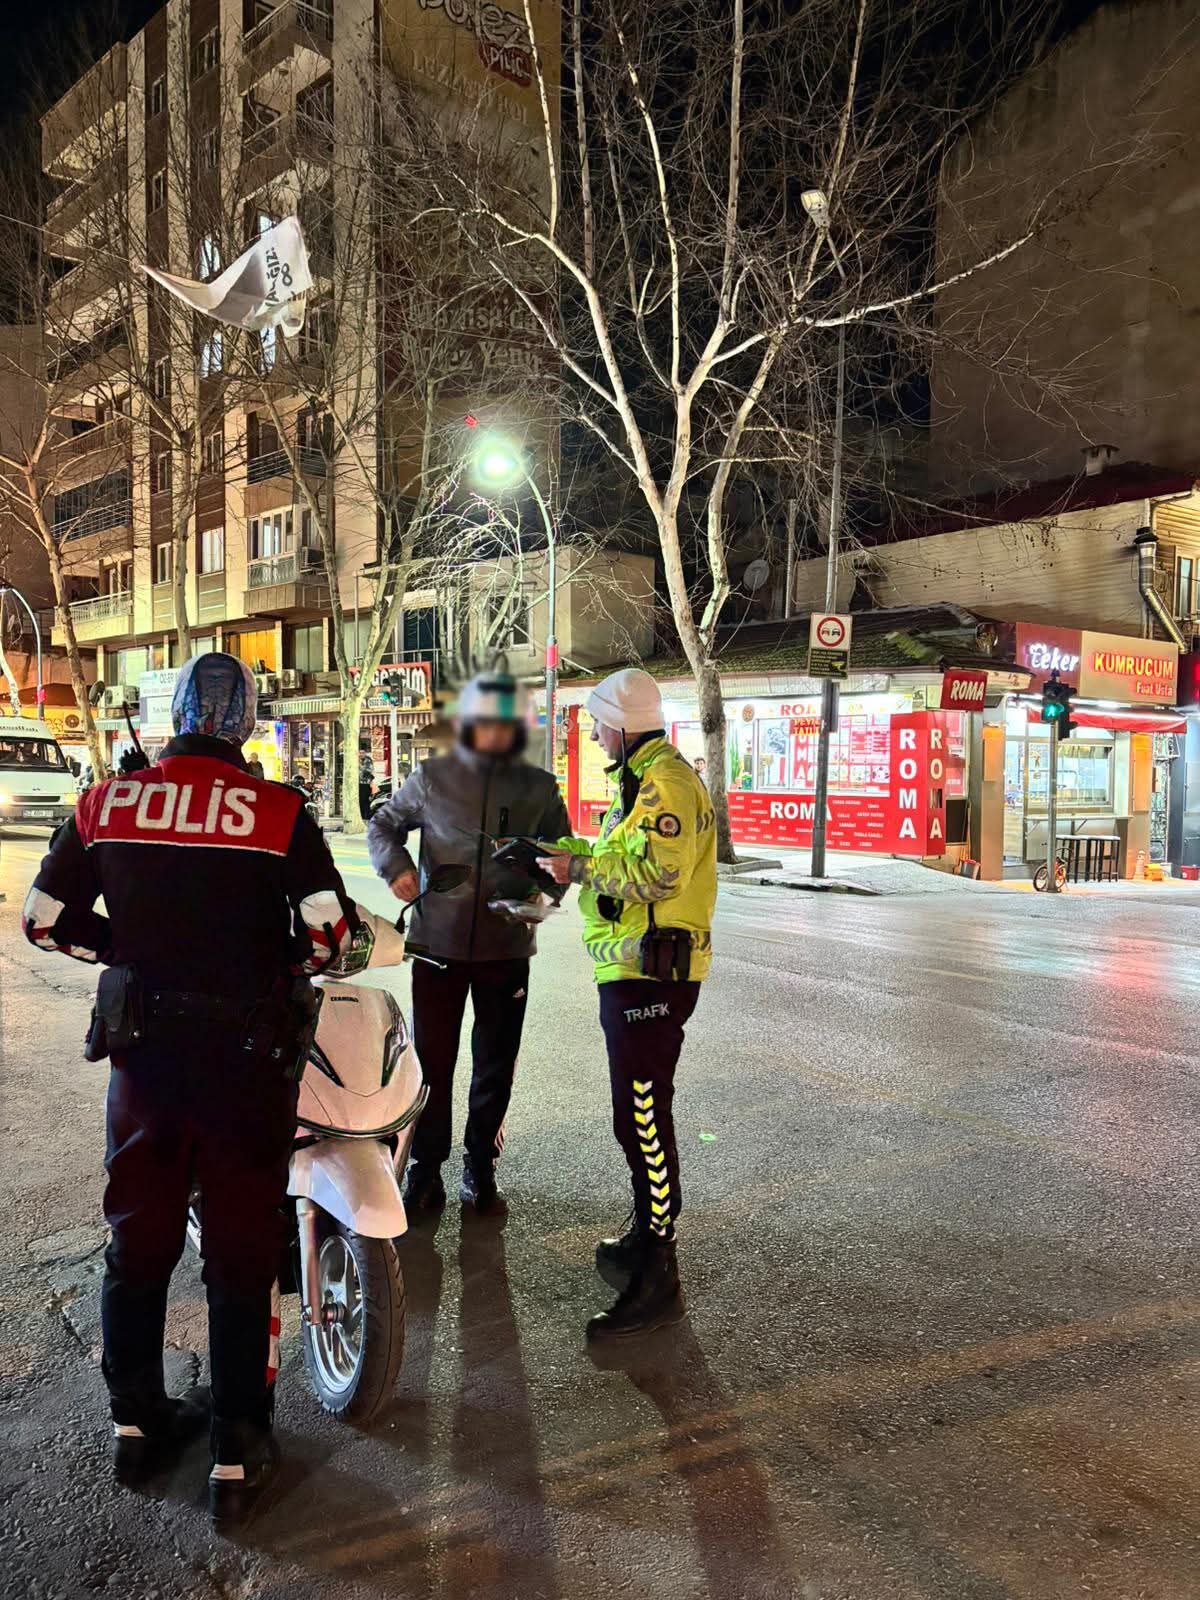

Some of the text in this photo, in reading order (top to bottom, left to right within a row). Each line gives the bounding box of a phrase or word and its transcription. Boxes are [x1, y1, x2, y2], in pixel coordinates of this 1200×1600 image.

[950, 679, 985, 701] ROMA
[1094, 652, 1174, 679] KUMRUCUM
[98, 779, 257, 837] POLİS
[899, 728, 917, 839] ROMA
[930, 728, 943, 839] ROMA
